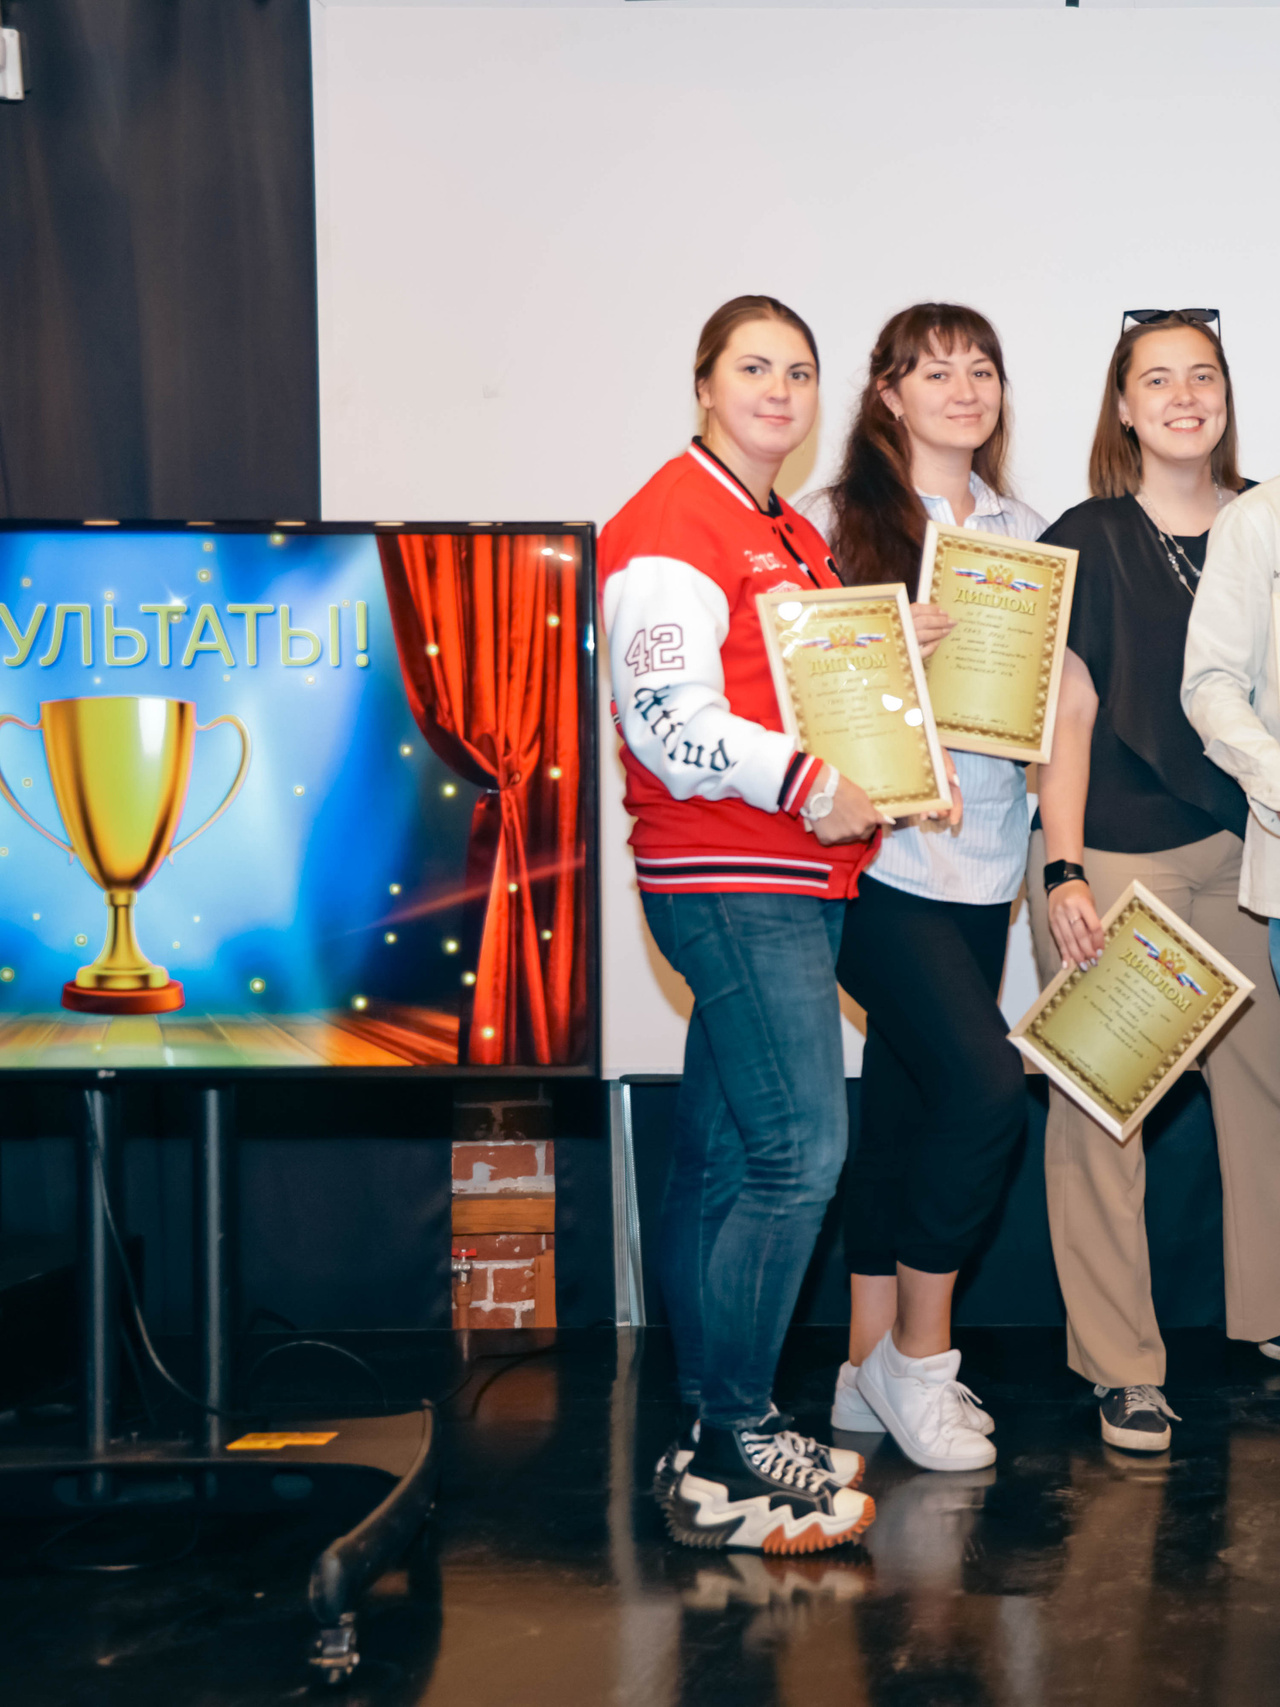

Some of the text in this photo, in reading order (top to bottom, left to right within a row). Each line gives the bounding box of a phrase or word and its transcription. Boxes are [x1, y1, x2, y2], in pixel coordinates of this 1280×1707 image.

[953, 586, 1037, 616] ДИПЛОМ
[0, 601, 369, 668] УЛЬТАТЫ!
[624, 623, 685, 677] 42
[1118, 948, 1192, 1013] ДИПЛОМ
